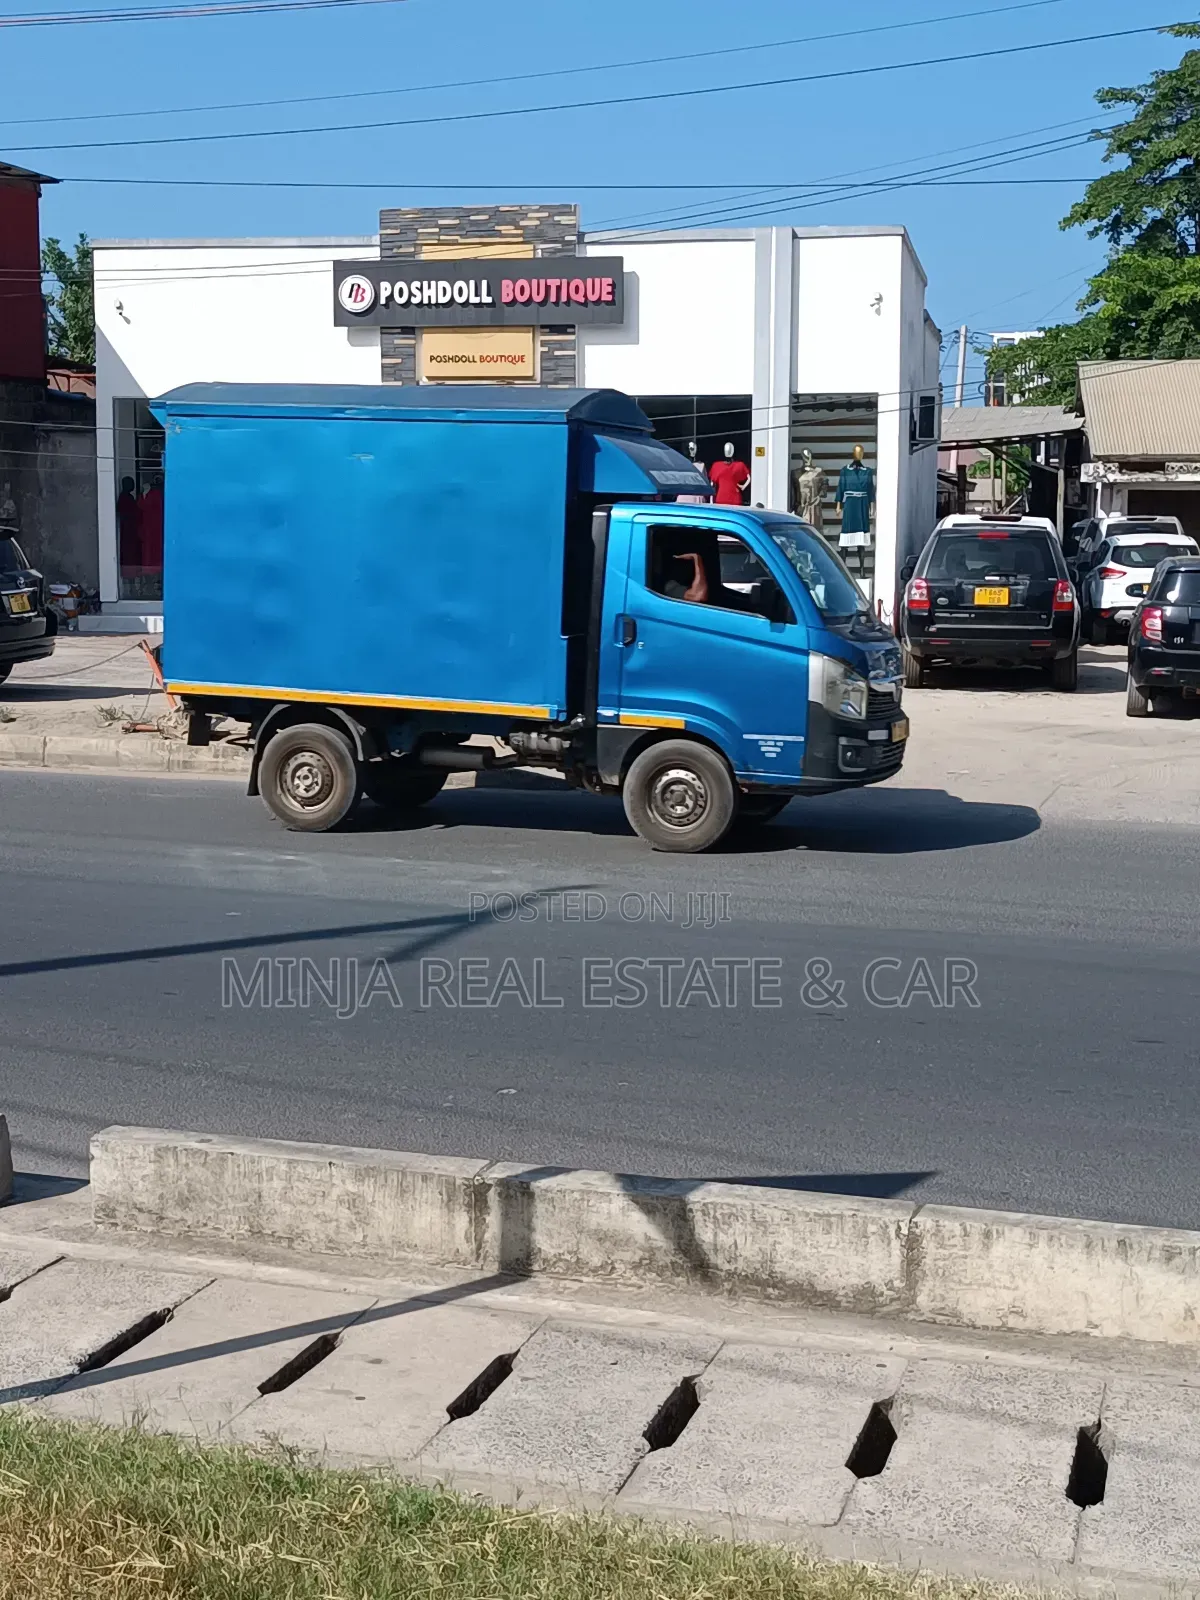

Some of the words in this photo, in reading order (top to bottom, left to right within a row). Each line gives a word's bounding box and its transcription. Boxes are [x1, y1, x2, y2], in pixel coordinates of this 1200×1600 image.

[380, 280, 492, 304] POSHDOLL
[501, 278, 613, 303] BOUTIQUE
[430, 355, 477, 363] POSHDOLL
[480, 355, 526, 365] BOUTIQUE
